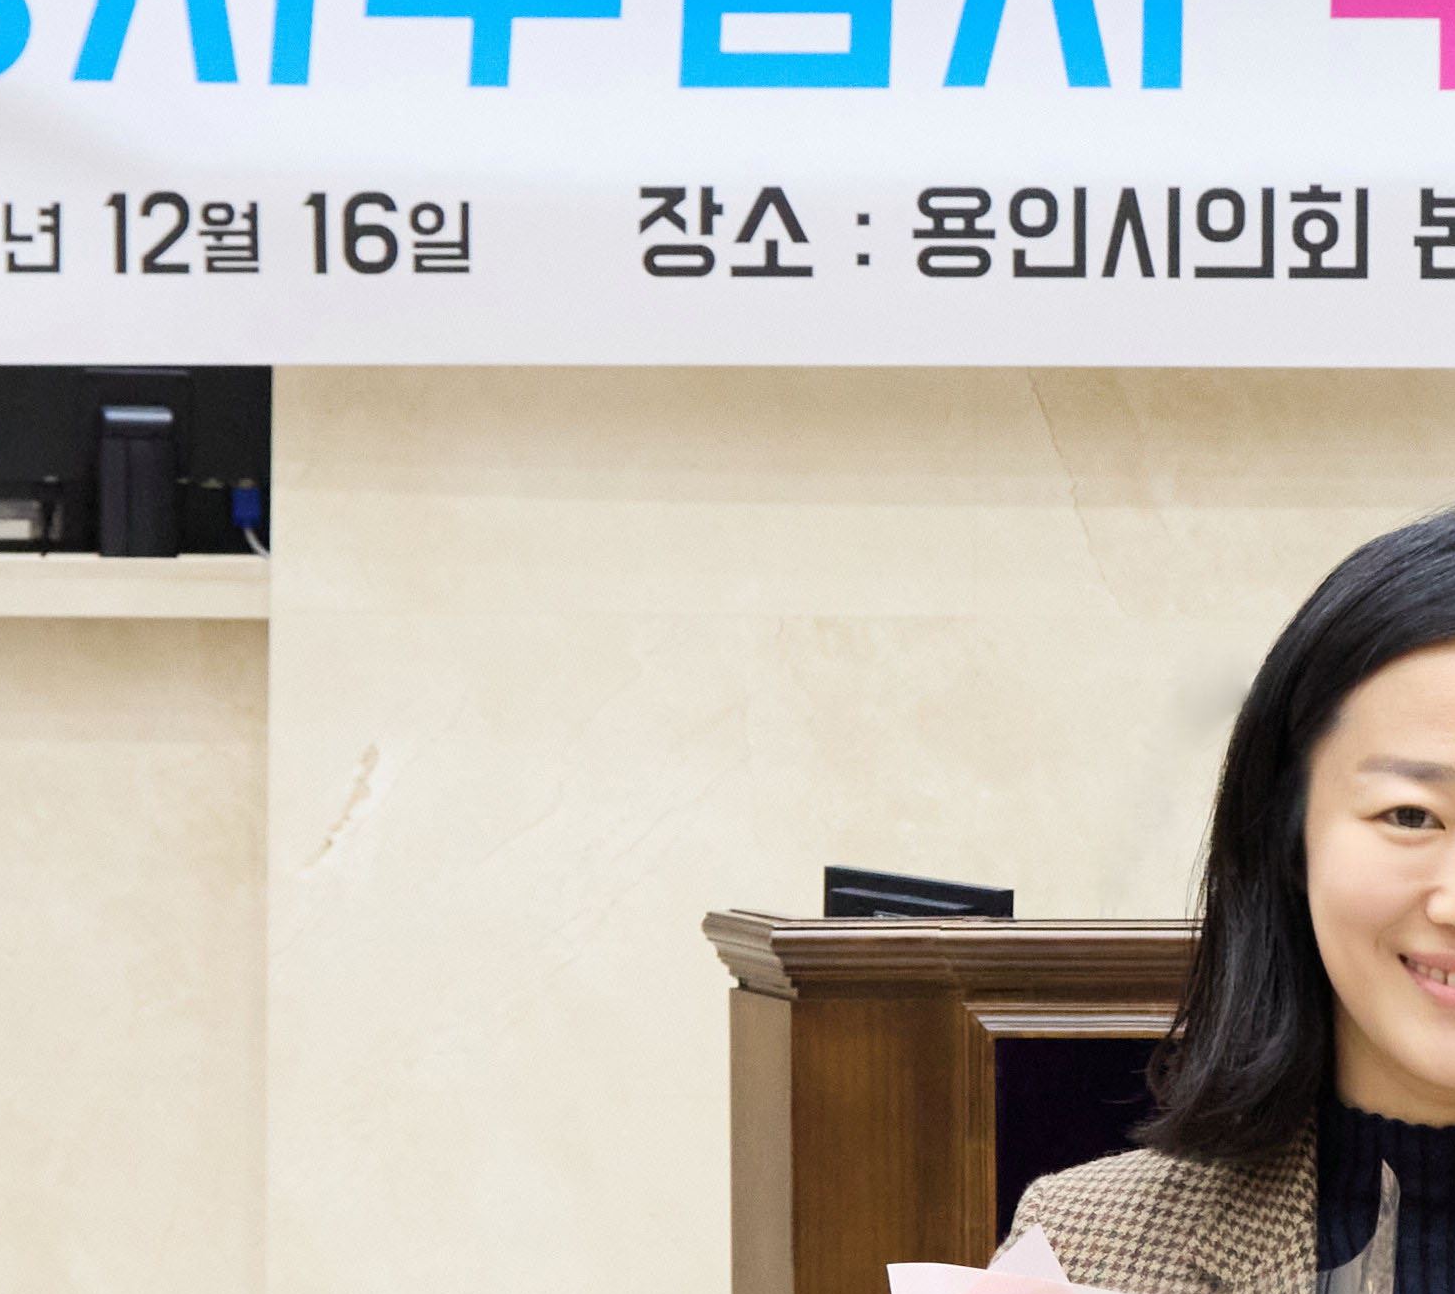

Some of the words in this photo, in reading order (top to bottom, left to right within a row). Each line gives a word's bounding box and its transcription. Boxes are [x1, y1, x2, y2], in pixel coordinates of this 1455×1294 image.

[106, 191, 260, 275] 12월
[304, 191, 470, 275] 16일
[639, 186, 814, 278] 장소
[912, 184, 1369, 280] 용인시의회
